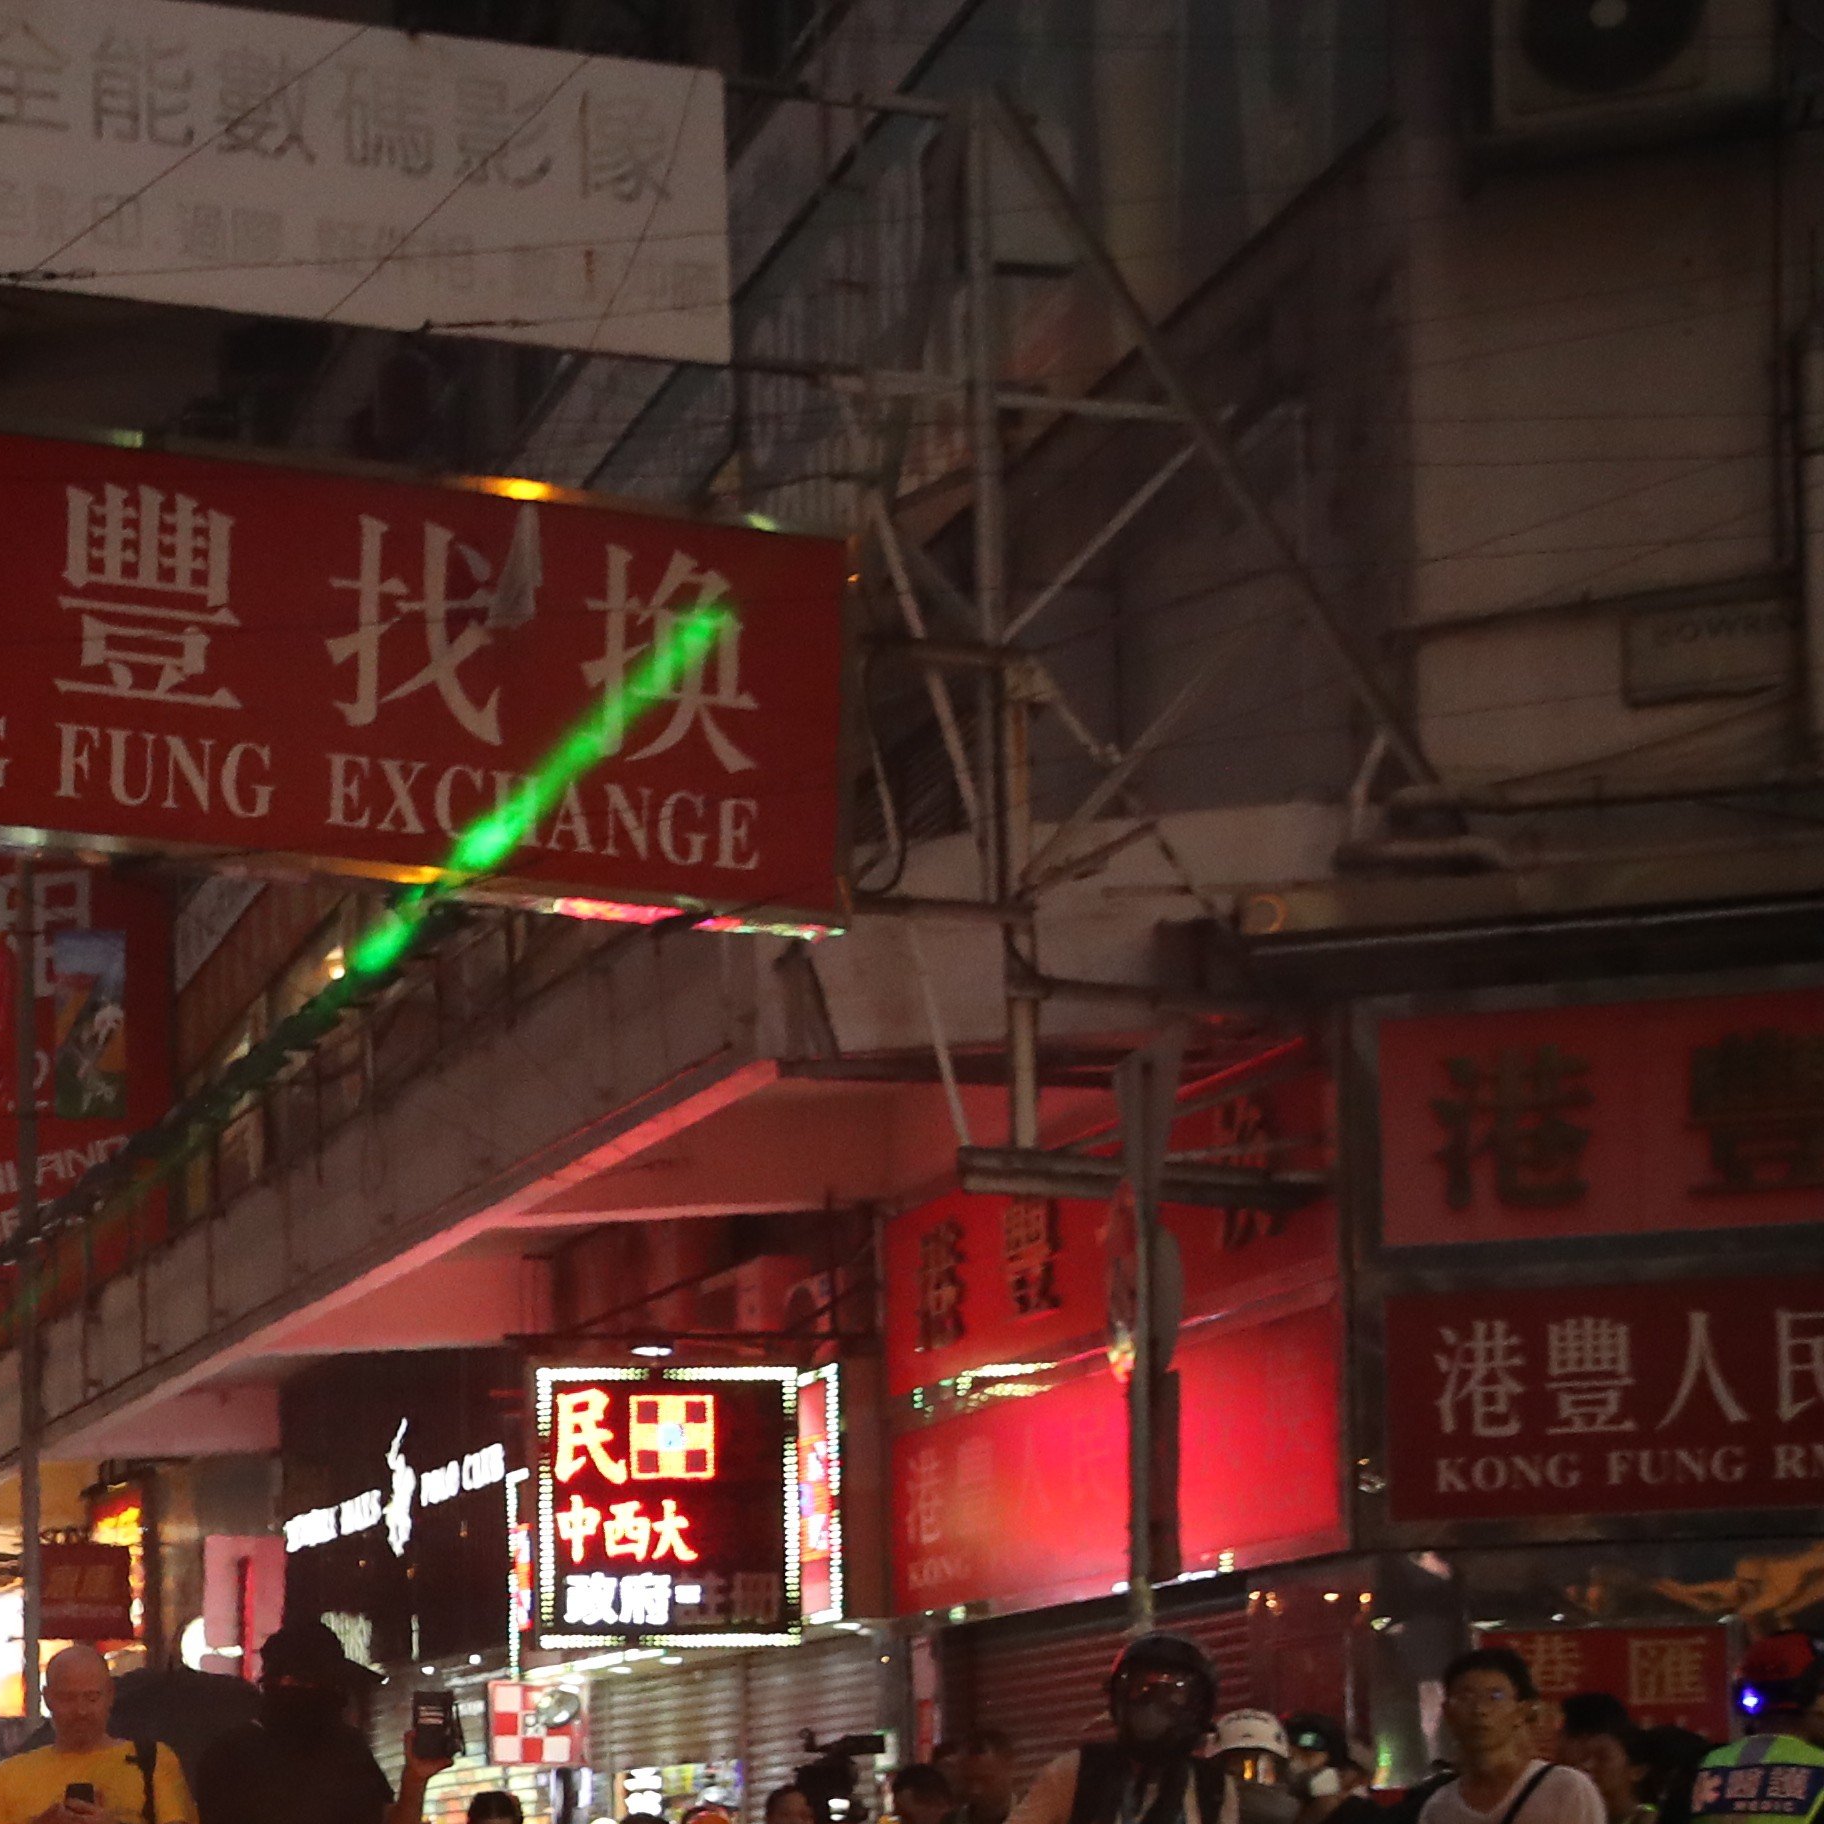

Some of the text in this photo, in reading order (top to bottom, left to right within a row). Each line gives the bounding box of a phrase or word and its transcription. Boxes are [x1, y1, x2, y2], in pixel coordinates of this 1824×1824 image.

[54, 721, 276, 820] FUNG
[325, 752, 760, 871] EXCHANGE
[554, 1388, 628, 1485] 民
[1436, 1453, 1583, 1494] KONG
[1606, 1444, 1749, 1486] FUNG
[555, 1494, 699, 1564] 中西大
